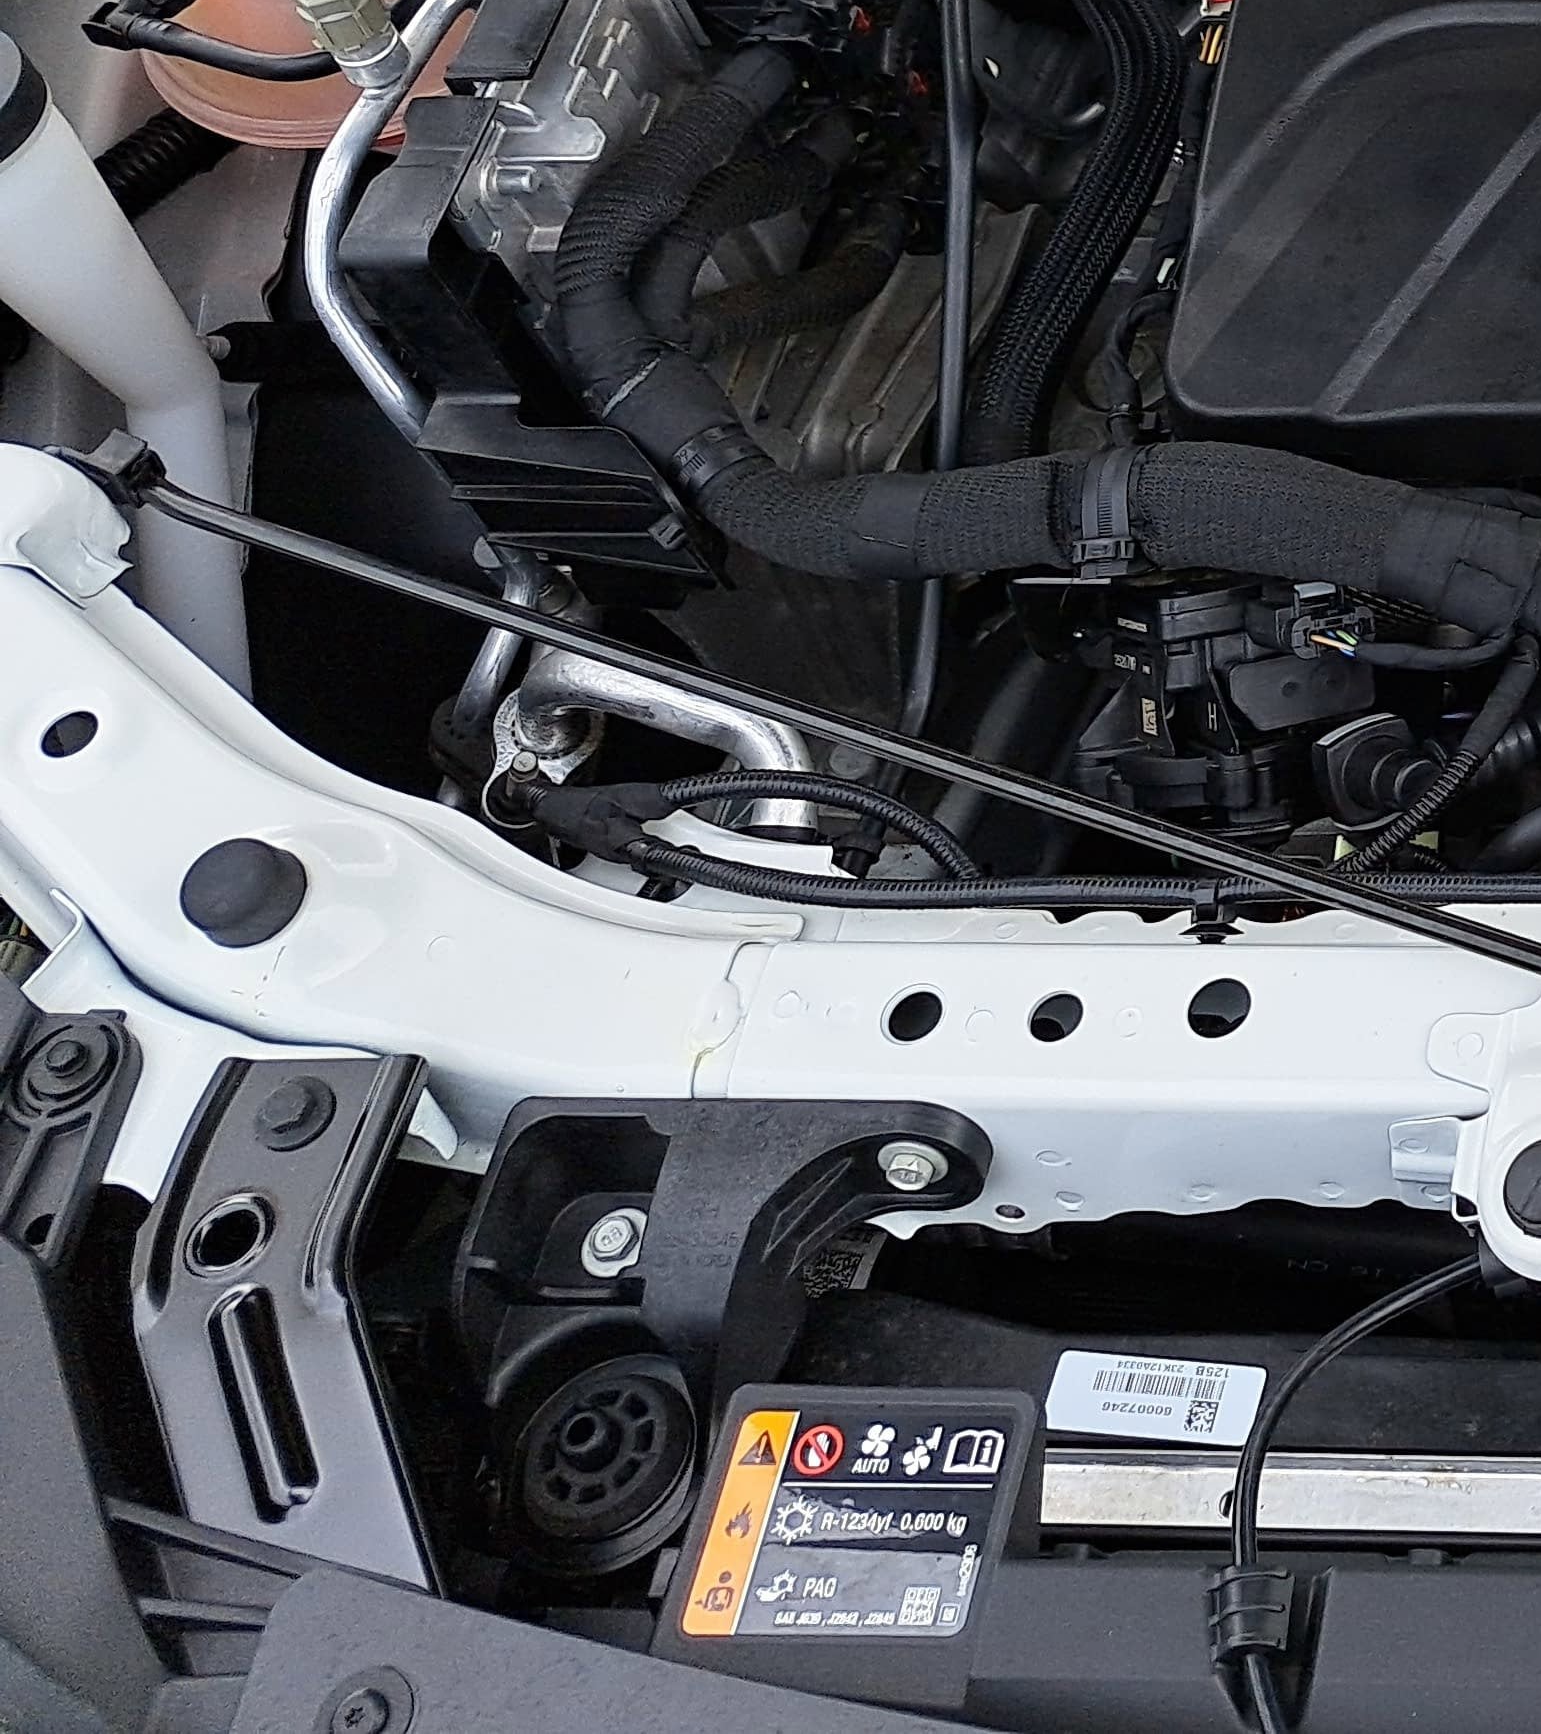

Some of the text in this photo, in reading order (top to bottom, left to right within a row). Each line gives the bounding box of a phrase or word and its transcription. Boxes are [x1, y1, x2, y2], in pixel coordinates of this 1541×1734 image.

[852, 1458, 890, 1473] AUTO
[820, 1512, 894, 1534] R-1234yf
[946, 1511, 968, 1537] kg
